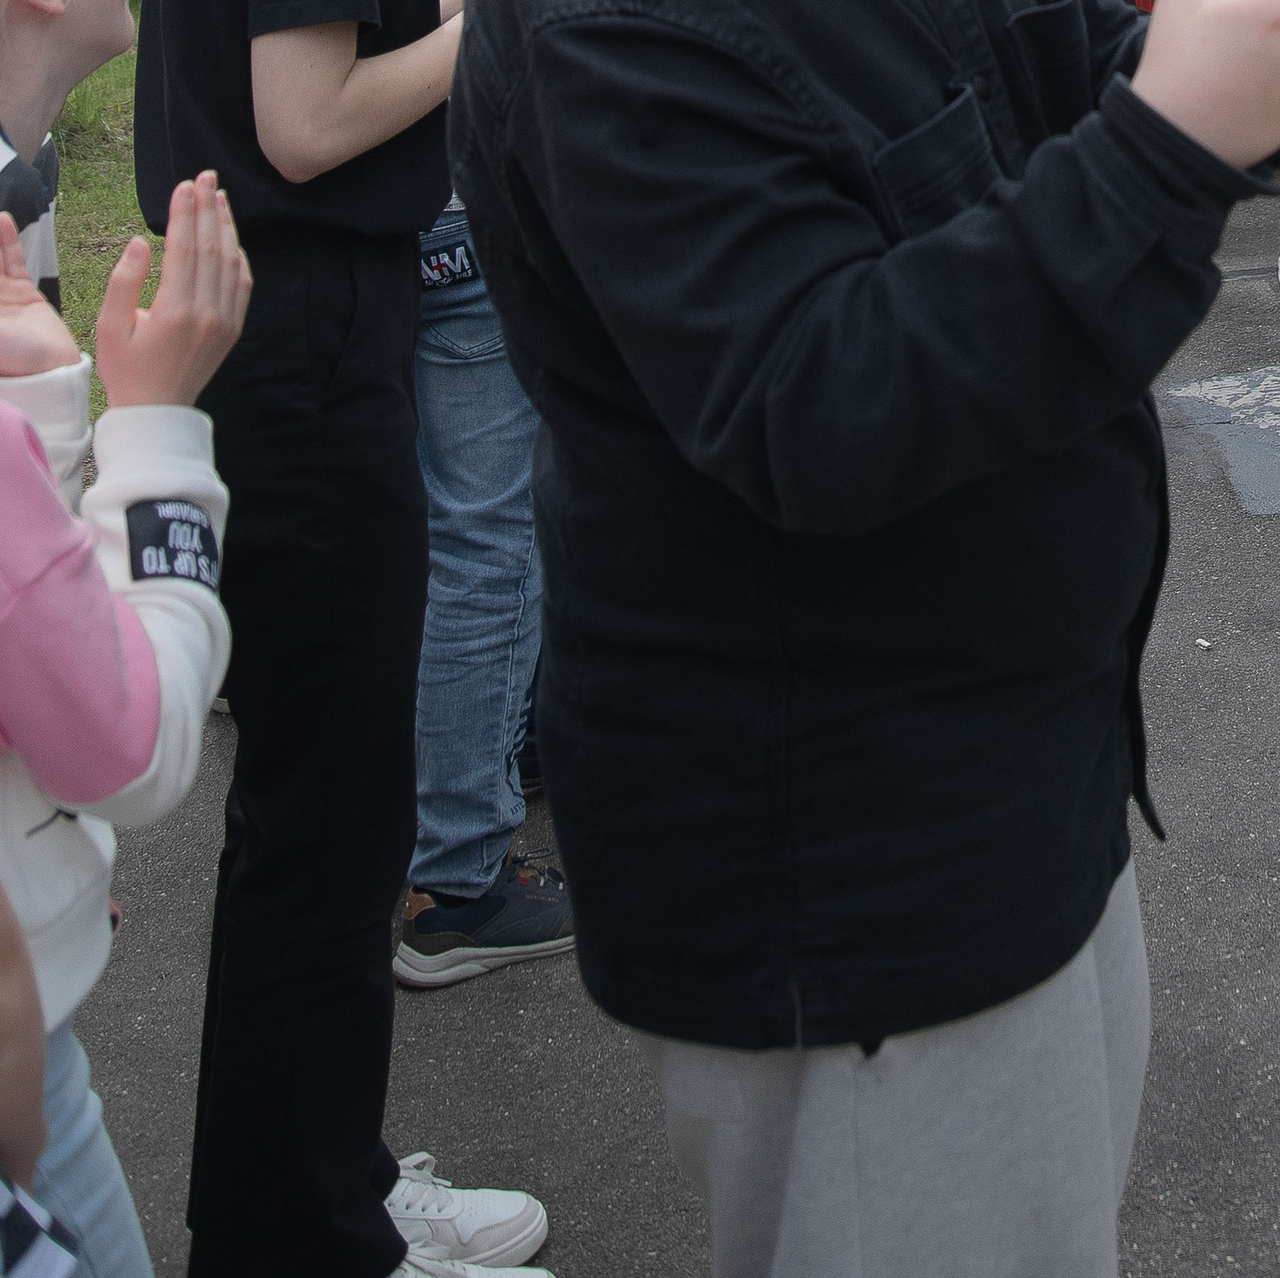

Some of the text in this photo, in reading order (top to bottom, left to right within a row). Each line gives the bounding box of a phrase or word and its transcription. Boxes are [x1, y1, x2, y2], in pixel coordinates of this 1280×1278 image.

[167, 520, 203, 554] YOU
[142, 545, 171, 575] TO
[173, 550, 198, 578] UP
